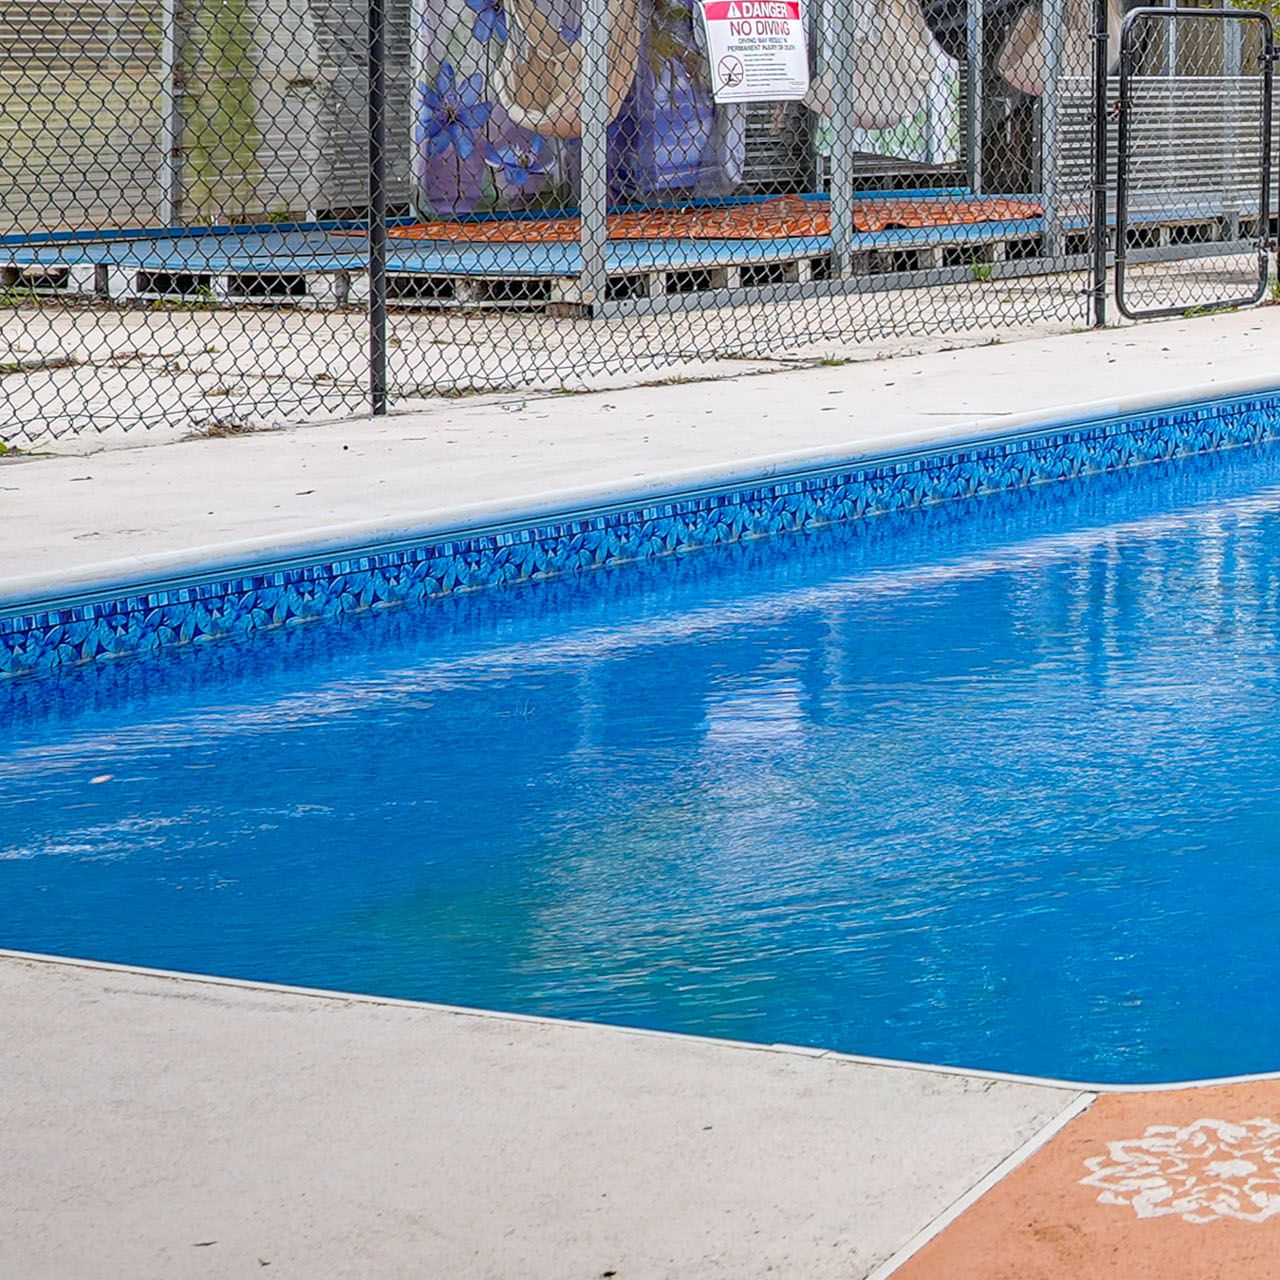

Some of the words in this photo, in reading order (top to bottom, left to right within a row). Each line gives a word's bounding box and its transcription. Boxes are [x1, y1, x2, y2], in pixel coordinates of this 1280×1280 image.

[742, 1, 788, 18] DANGER
[730, 20, 752, 36] NO
[756, 20, 790, 36] DIVING
